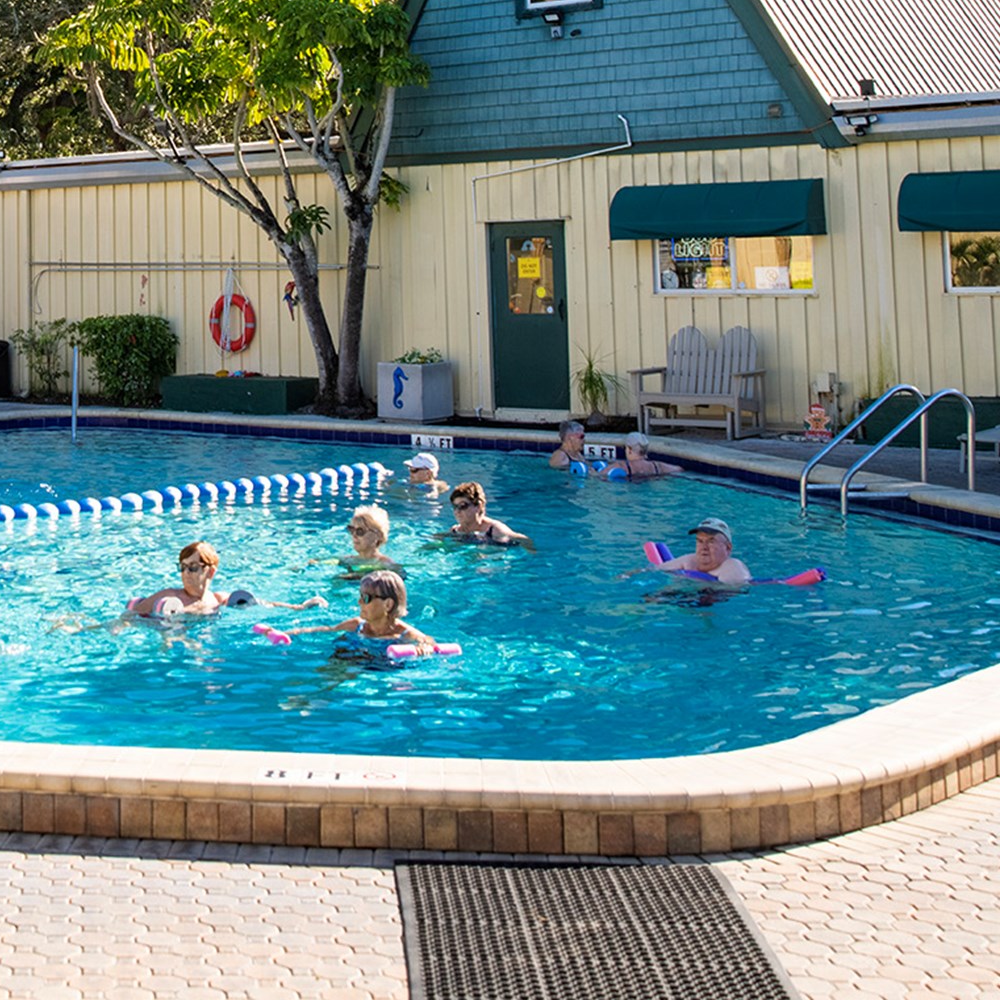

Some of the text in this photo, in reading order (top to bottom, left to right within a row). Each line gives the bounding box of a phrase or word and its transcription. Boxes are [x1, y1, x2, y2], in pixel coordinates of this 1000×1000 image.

[674, 240, 725, 257] LIGHT
[440, 437, 452, 448] FT
[588, 446, 614, 459] 5 FT
